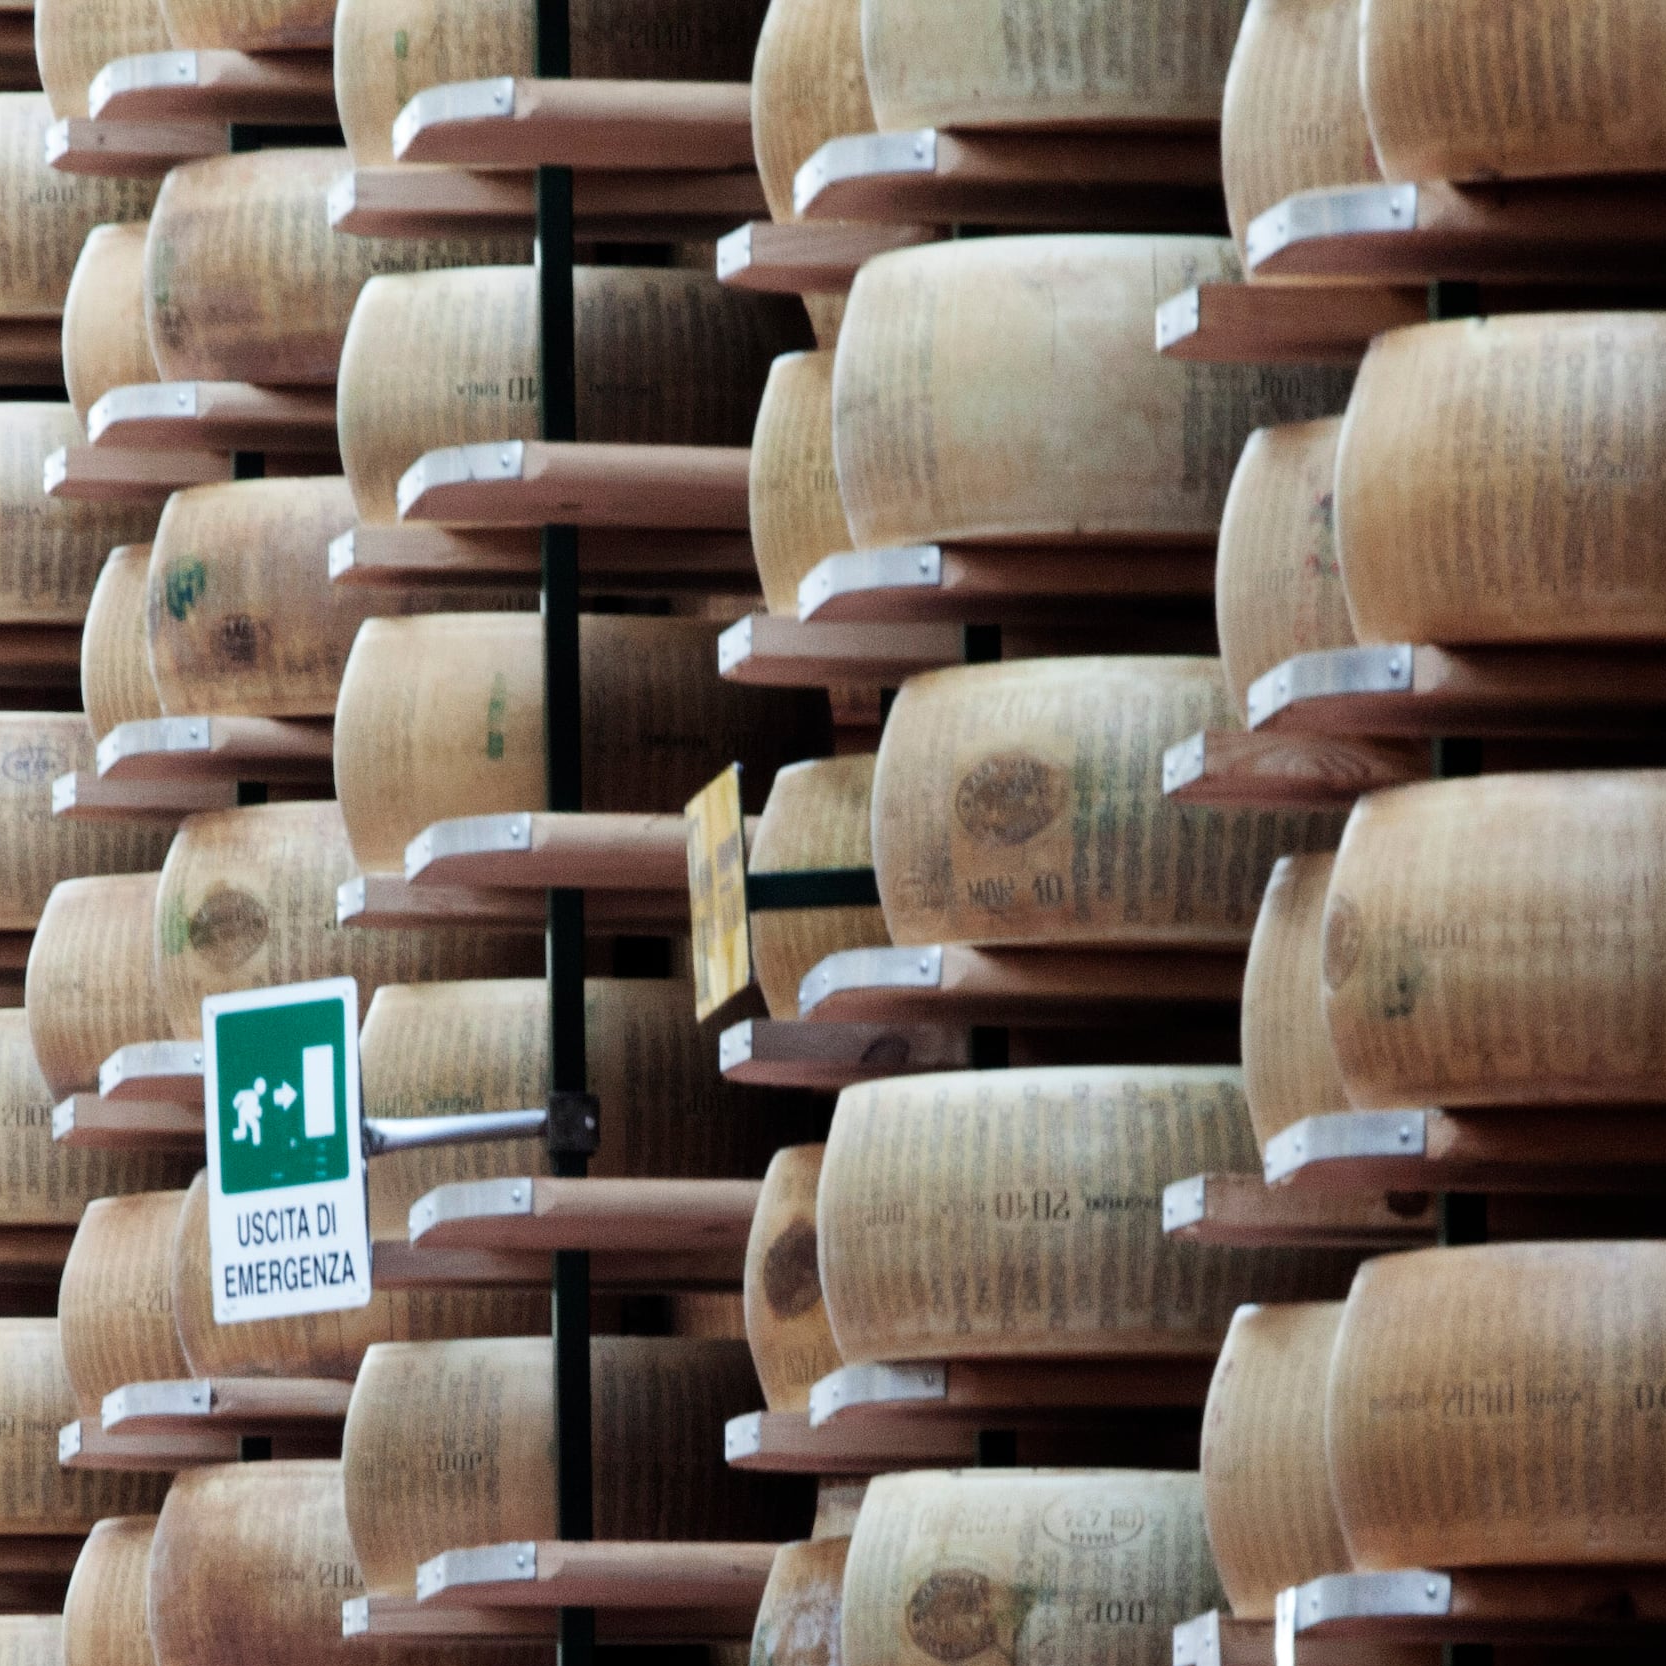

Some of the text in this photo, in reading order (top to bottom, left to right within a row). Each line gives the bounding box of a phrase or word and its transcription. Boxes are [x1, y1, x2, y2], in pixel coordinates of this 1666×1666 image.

[237, 1202, 337, 1246] USCITA DI
[224, 1250, 356, 1299] EMERGENZA
